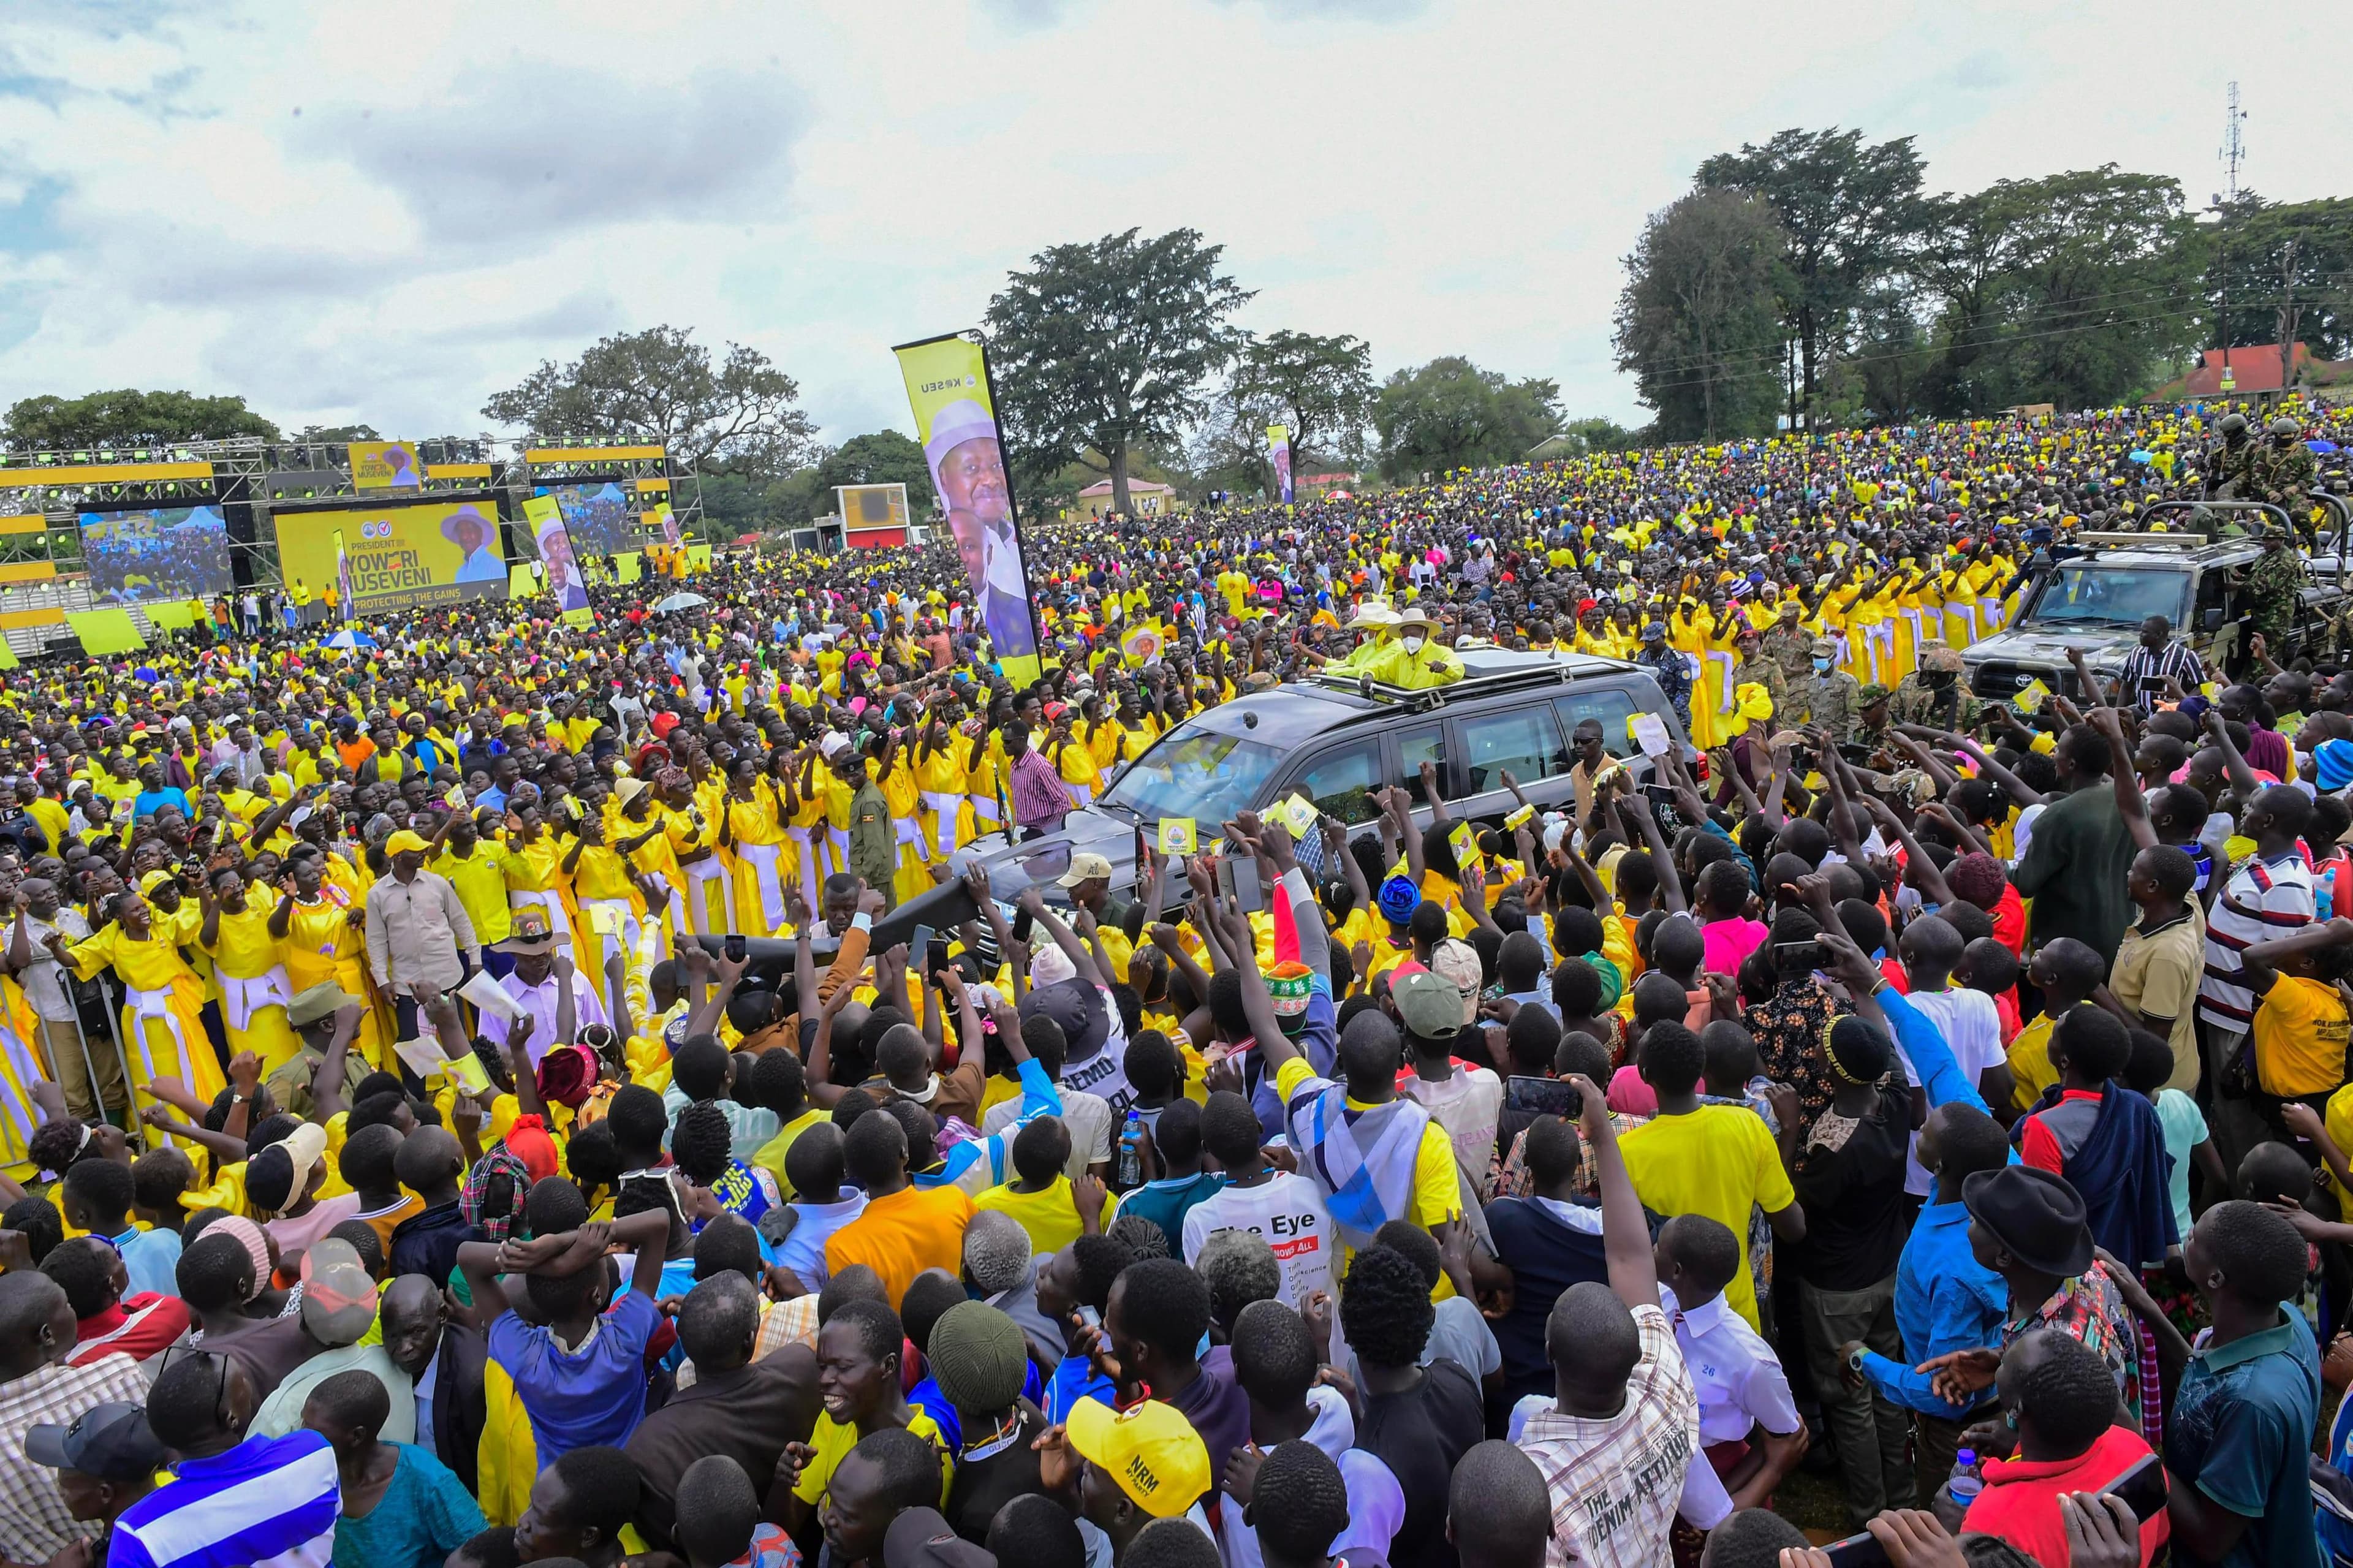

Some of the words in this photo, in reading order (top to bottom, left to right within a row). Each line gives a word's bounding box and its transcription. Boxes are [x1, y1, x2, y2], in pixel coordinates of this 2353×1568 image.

[351, 540, 395, 551] PRESIDENT
[354, 594, 412, 610] PROTECTING
[415, 591, 432, 601] THE
[434, 588, 461, 600] GAINS
[1271, 1214, 1316, 1236] Eye
[1273, 1245, 1295, 1257] NOWS
[1297, 1241, 1313, 1252] ALL
[1702, 1364, 1716, 1377] 26
[1125, 1467, 1134, 1478] MY
[1131, 1477, 1150, 1498] PARTY
[1131, 1453, 1160, 1493] NRM
[1589, 1493, 1634, 1550] DENIM
[1634, 1429, 1690, 1506] ATTITUD
[1583, 1489, 1612, 1518] THE
